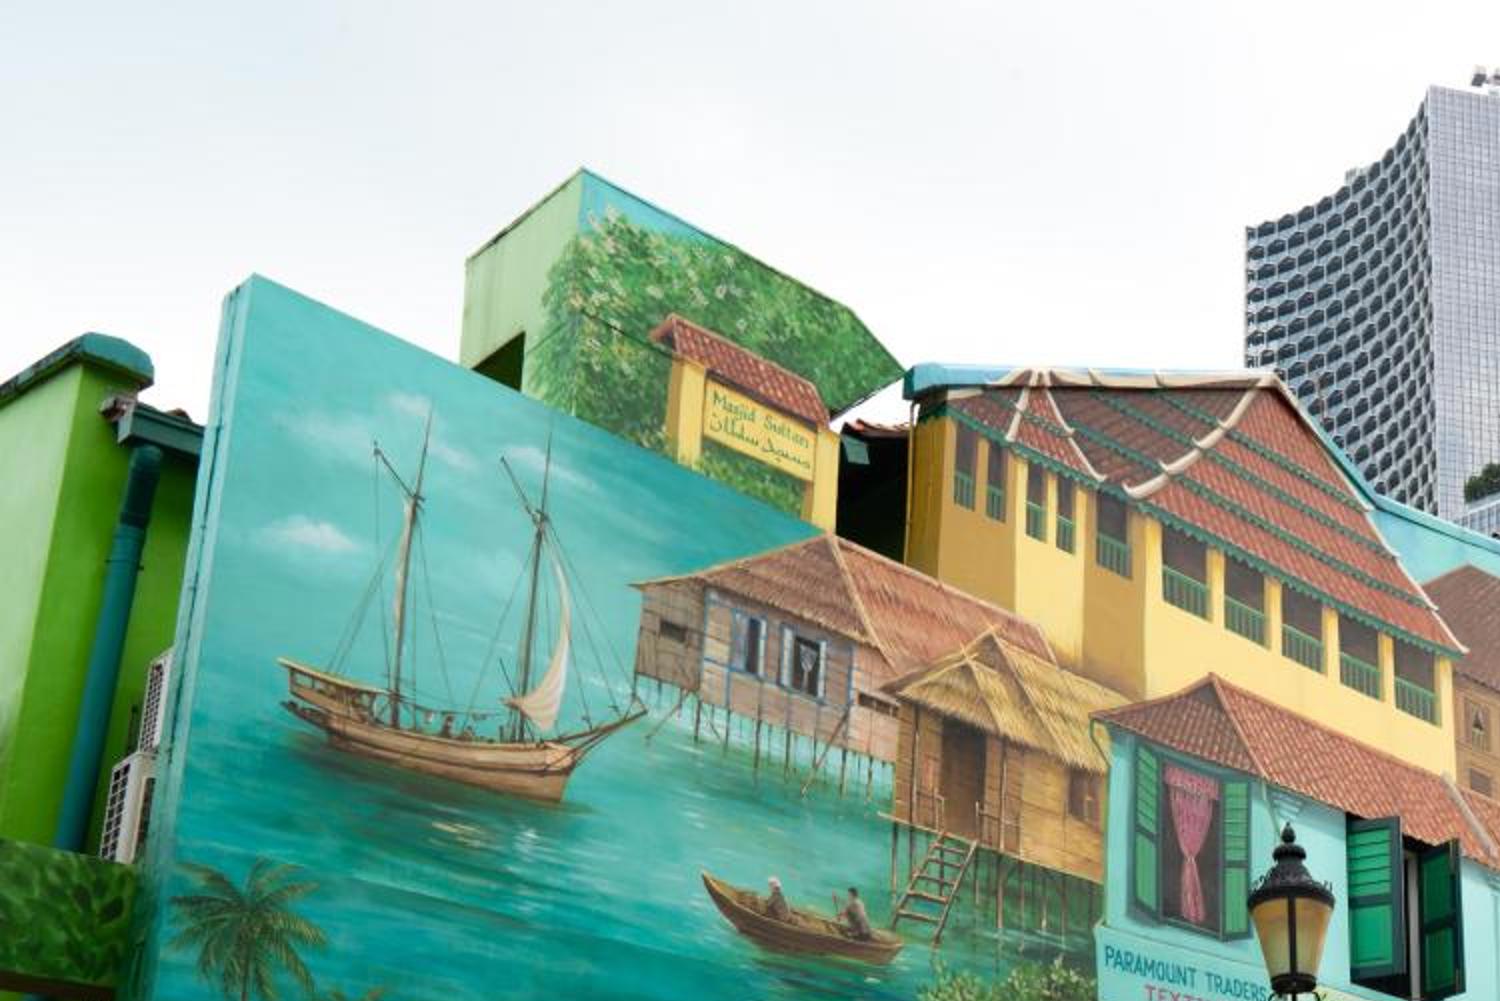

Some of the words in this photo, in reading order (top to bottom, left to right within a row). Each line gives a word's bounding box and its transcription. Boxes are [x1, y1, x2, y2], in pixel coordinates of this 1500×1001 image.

[713, 390, 757, 421] Masjid
[763, 413, 809, 449] Sultan
[1104, 945, 1198, 989] PARAMOUNT
